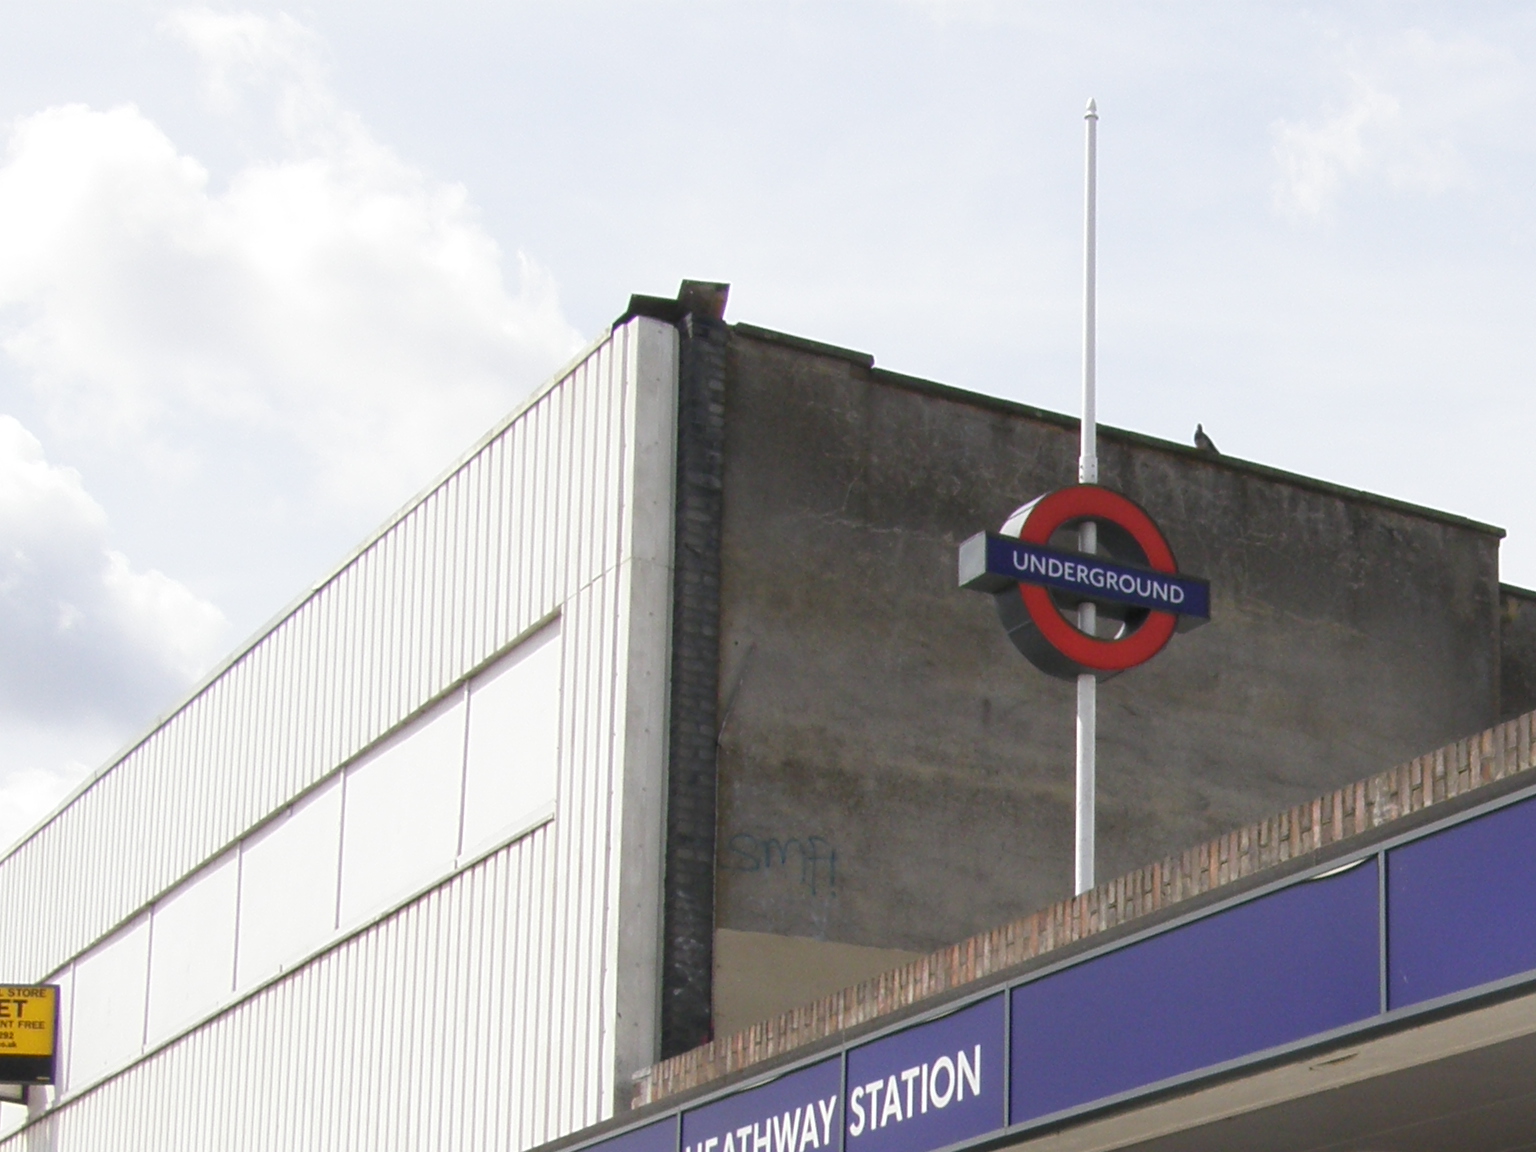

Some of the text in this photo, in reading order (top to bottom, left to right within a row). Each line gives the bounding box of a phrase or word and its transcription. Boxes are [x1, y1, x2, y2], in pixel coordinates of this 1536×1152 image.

[1013, 550, 1185, 604] UNDERGROUND
[8, 988, 47, 998] STORE
[18, 1020, 46, 1030] FREE
[850, 1044, 981, 1137] STATION
